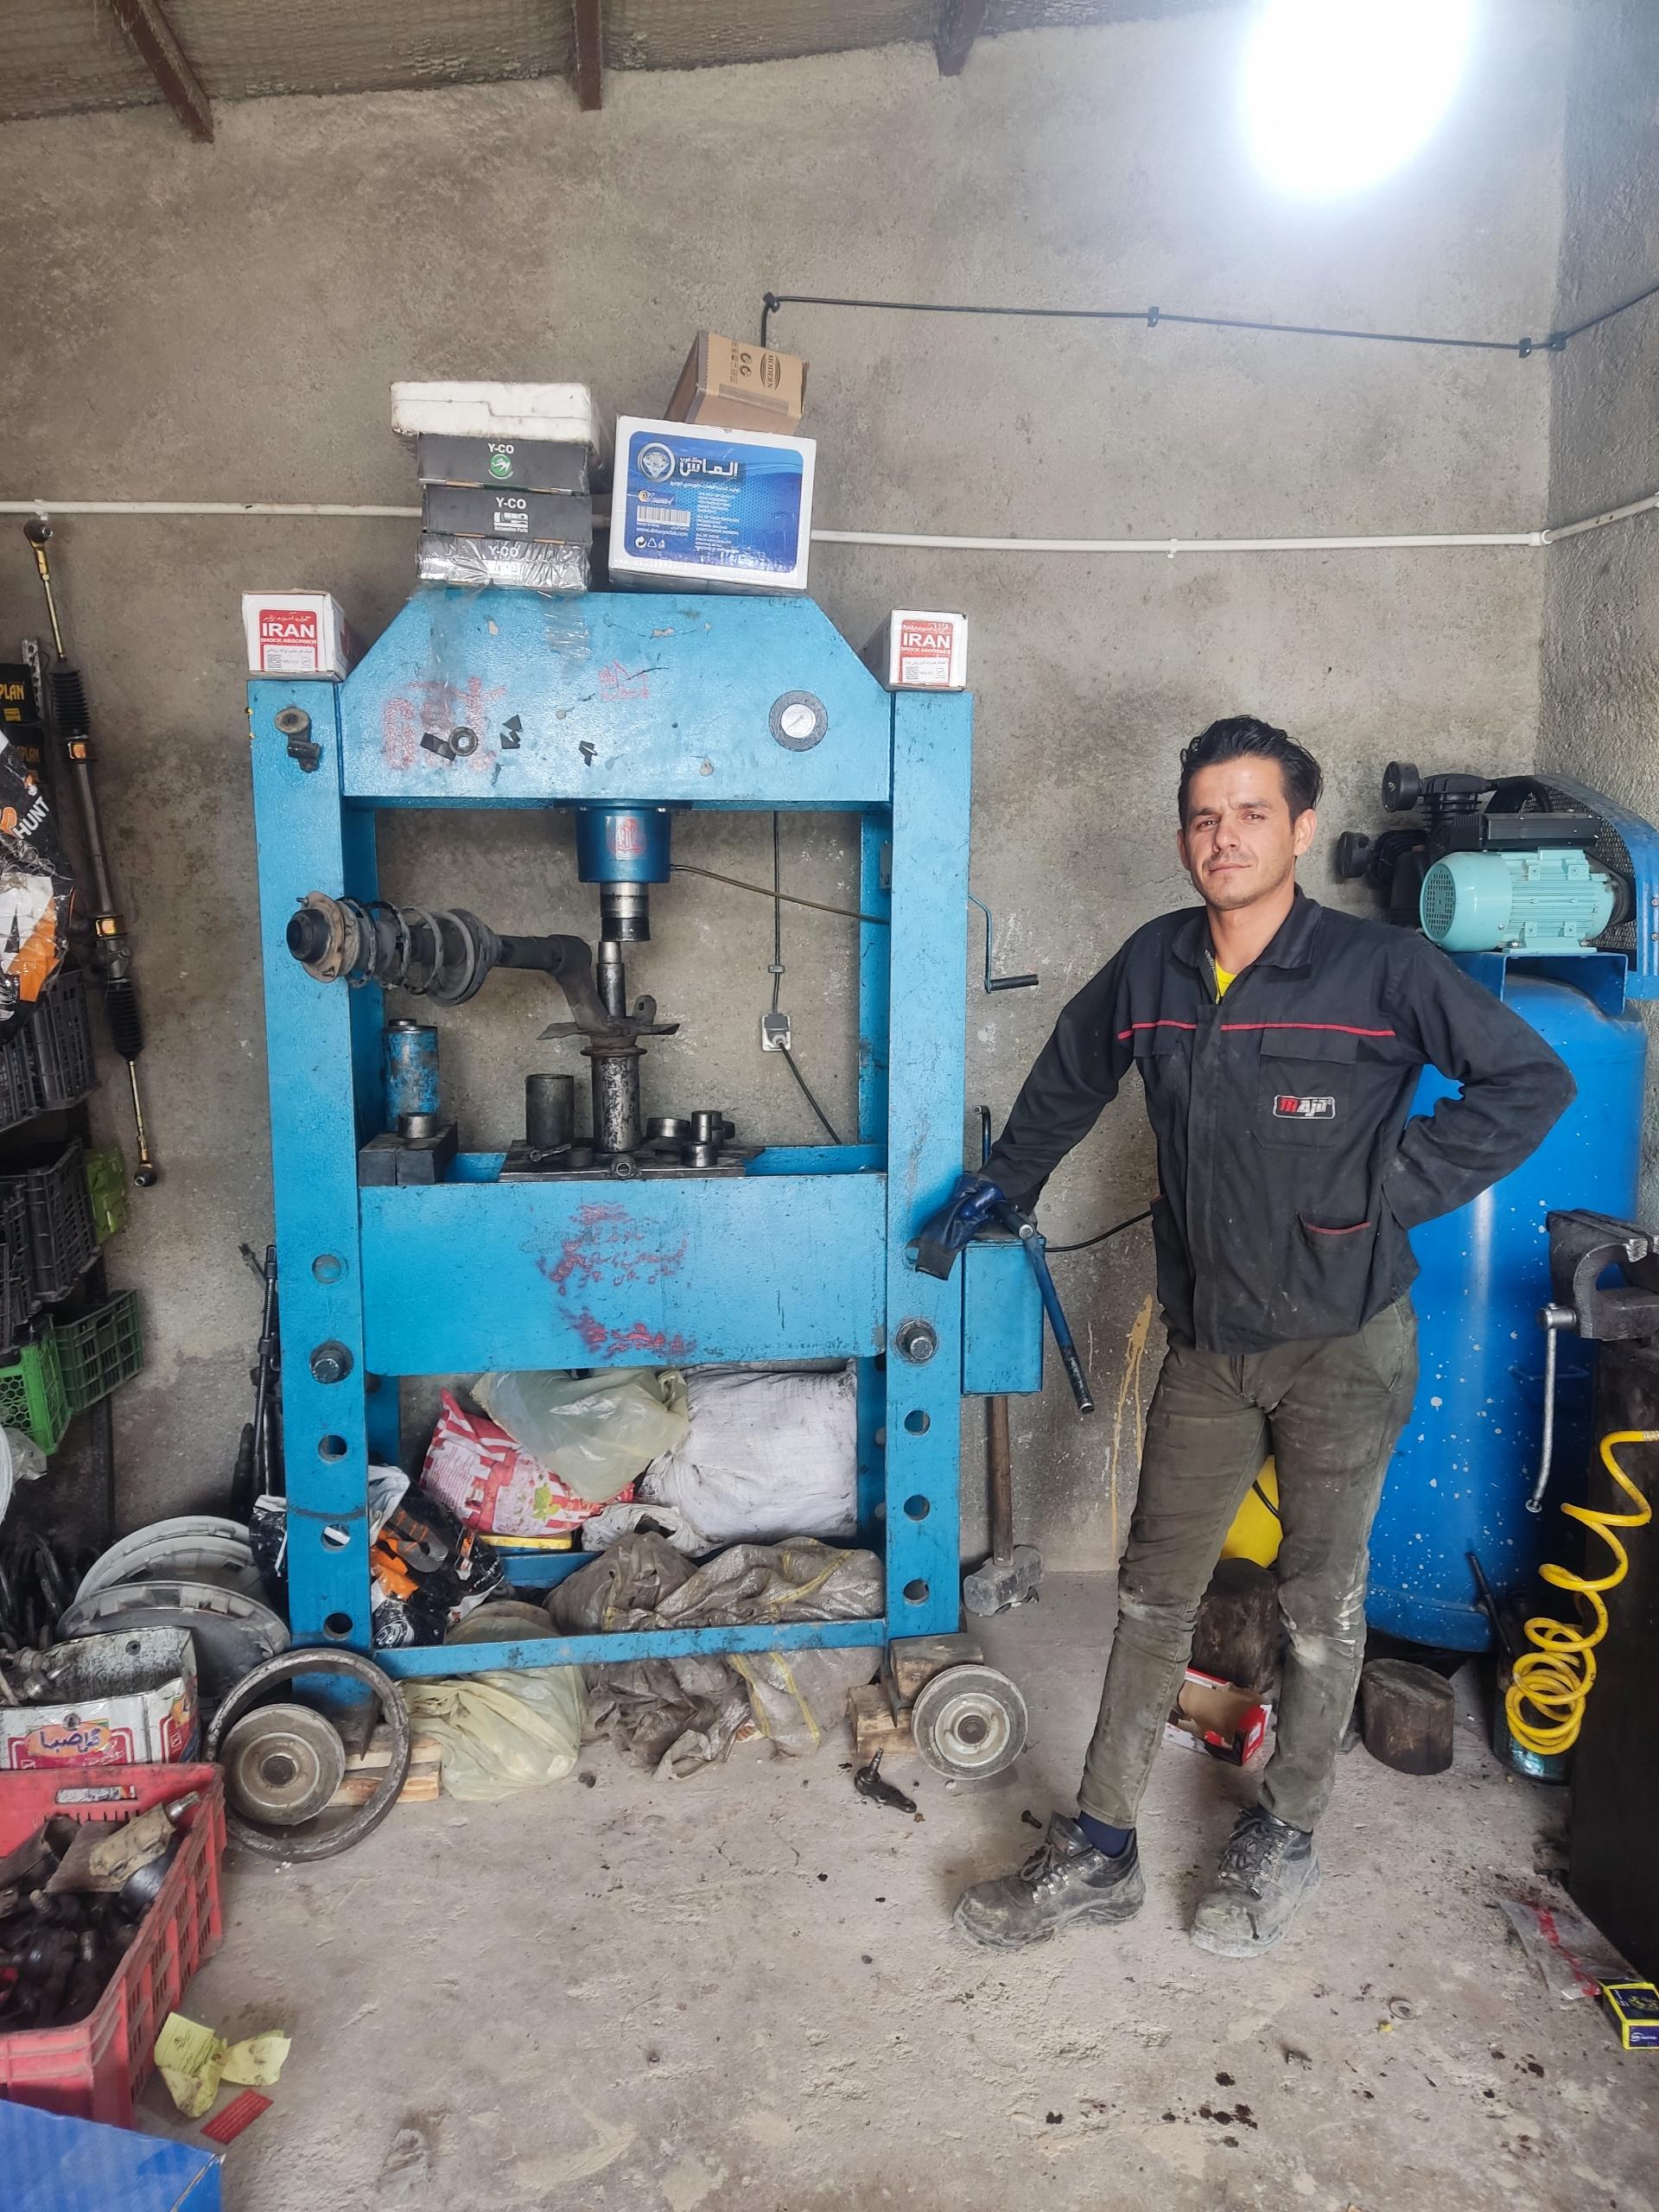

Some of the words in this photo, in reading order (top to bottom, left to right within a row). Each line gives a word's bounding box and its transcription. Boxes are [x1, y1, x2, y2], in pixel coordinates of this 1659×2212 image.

[487, 443, 514, 454] Y-CO
[679, 458, 739, 477] الماس
[495, 497, 527, 509] Y-CO
[488, 545, 519, 557] Y-CO
[262, 623, 315, 639] IRAN
[903, 632, 950, 649] IRAN
